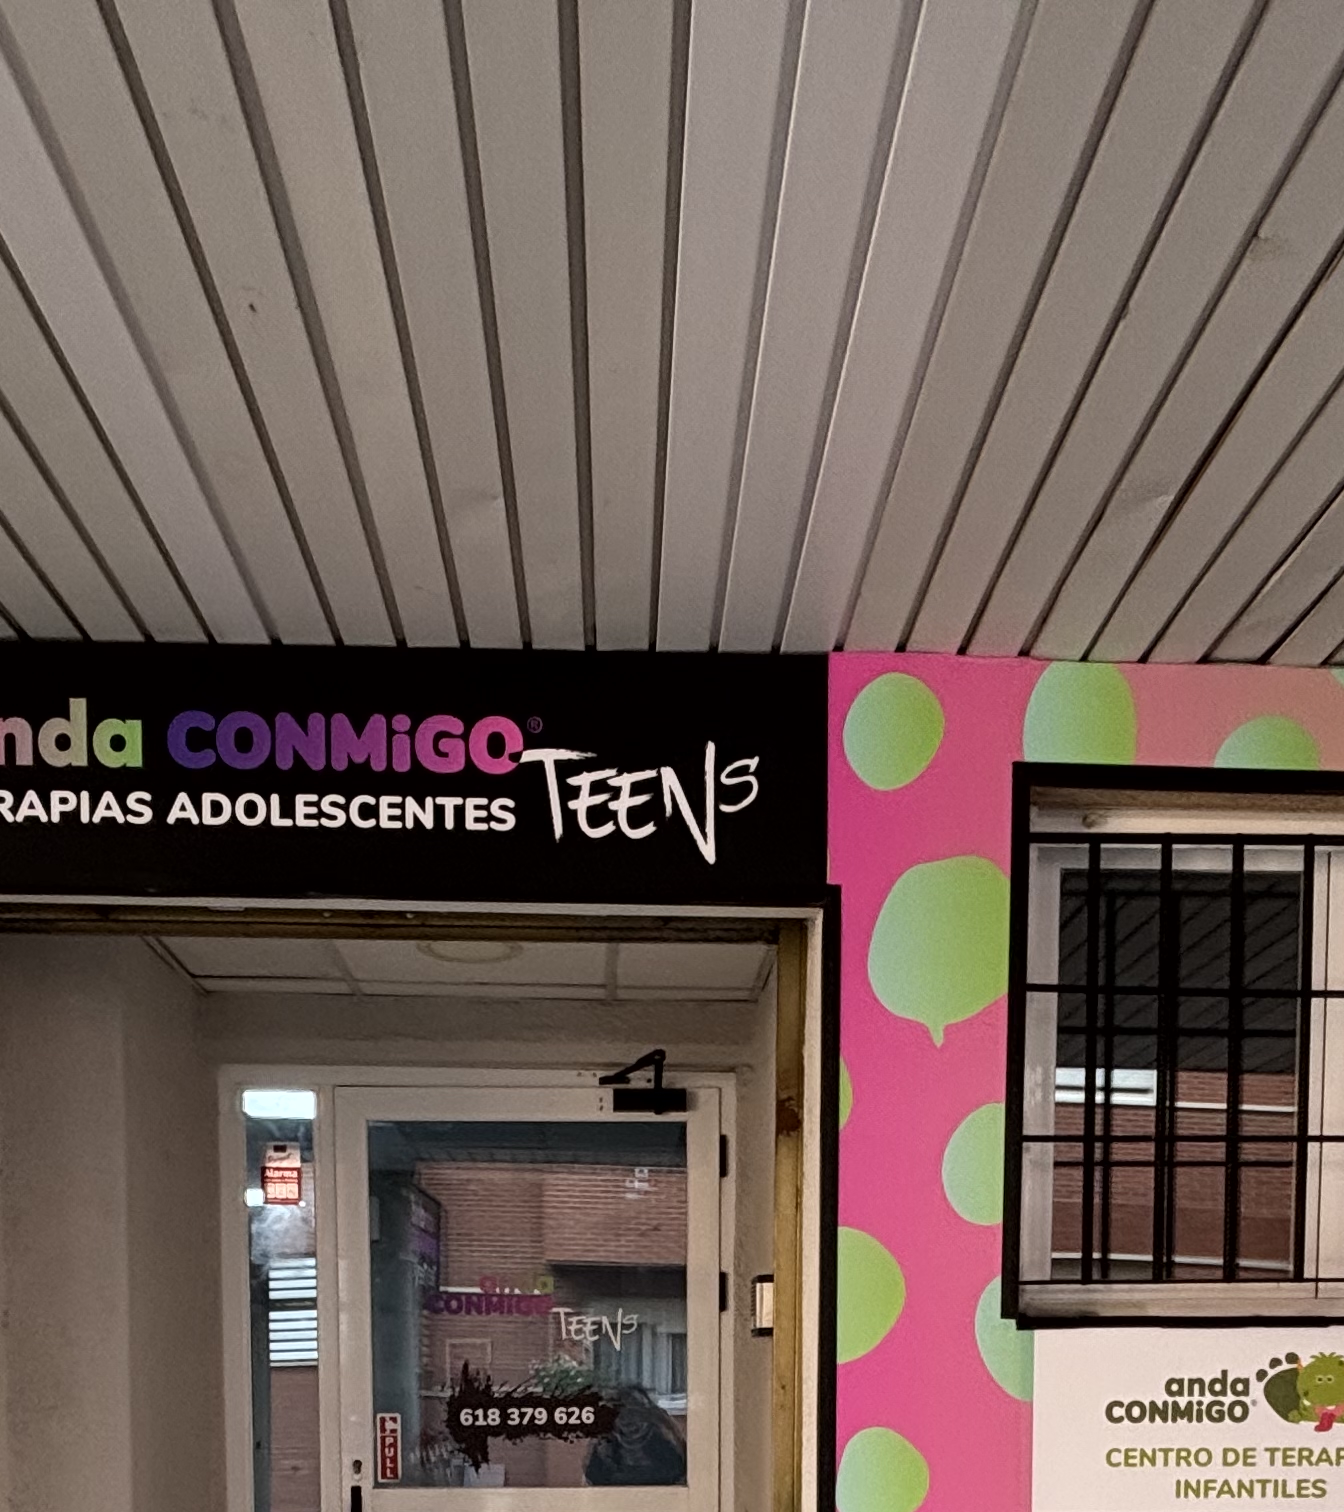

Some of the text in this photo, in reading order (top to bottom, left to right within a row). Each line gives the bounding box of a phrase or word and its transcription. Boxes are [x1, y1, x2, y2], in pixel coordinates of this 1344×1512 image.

[165, 791, 517, 831] ADOLESCENTES
[264, 1168, 298, 1177] Alarma
[1164, 1369, 1250, 1398] anda
[459, 1407, 595, 1426] 618 379 626
[384, 1436, 395, 1478] PULL
[1105, 1447, 1214, 1468] CENTRO
[1222, 1447, 1257, 1467] DE
[1175, 1479, 1327, 1499] INFANTILES
